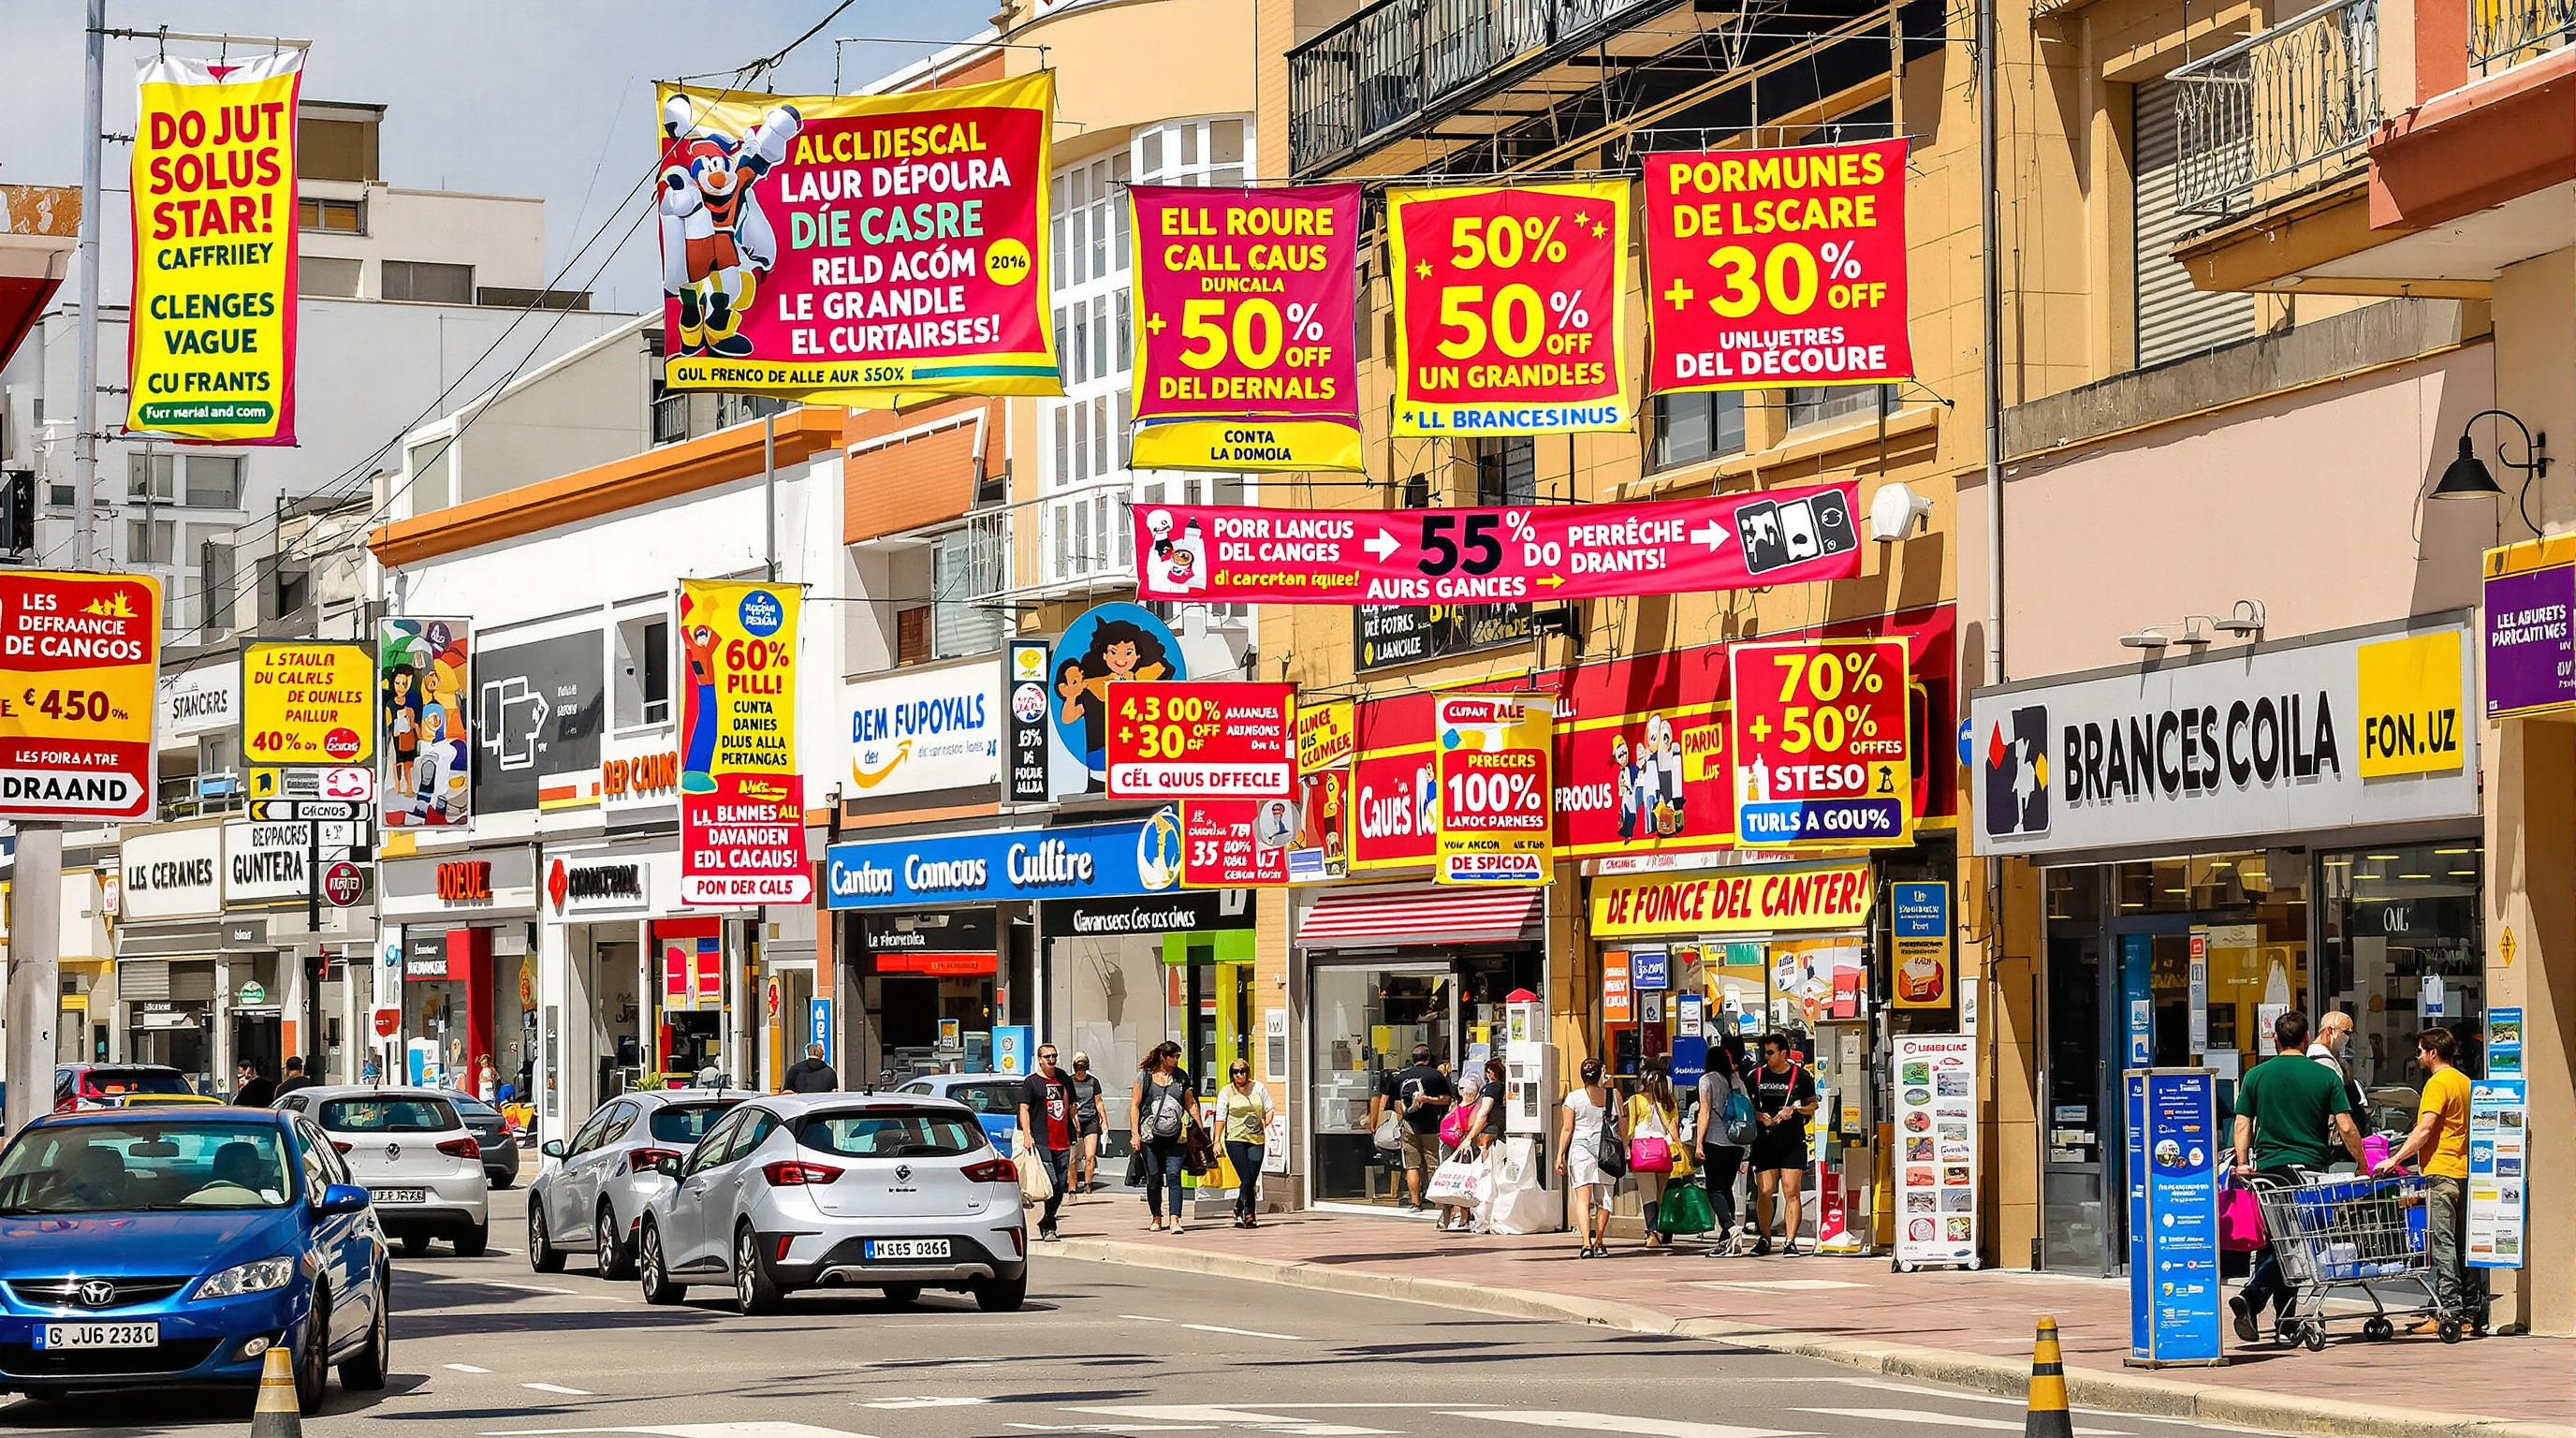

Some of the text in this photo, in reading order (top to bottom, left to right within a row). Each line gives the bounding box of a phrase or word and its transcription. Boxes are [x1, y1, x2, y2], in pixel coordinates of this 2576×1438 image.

[151, 101, 284, 150] DO JUT
[150, 146, 281, 195] SOLUS
[1669, 152, 1885, 196] PORMUNES
[781, 169, 863, 203] LAUR
[153, 193, 272, 241] STAR!
[790, 199, 984, 250] DÍE CASRE
[1161, 206, 1335, 236] ELL ROURE
[1673, 195, 1877, 238] DE LSCARE
[1450, 214, 1568, 270] 50%
[812, 243, 976, 286] RELD ACÓM
[1164, 243, 1328, 271] CALL CAUS
[1201, 276, 1285, 293] DUNCALA
[1827, 282, 1888, 310] OFF
[150, 291, 275, 320] CLENGES
[779, 285, 966, 321] LE GRANDLE
[164, 328, 257, 355] VAGUE
[791, 314, 1001, 355] EL CURTAIRSES!
[1545, 332, 1594, 356] OFF
[1285, 346, 1333, 369] OFF
[1676, 352, 1733, 378] DEL
[148, 371, 271, 394] CU FRANTS
[678, 367, 707, 382] GUL
[710, 368, 764, 382] PRENCO
[768, 370, 786, 383] DE
[789, 370, 825, 384] ALLE
[1160, 376, 1337, 401] DEL DERNALS
[1418, 362, 1606, 390] UN GRANDLES
[1454, 406, 1619, 429] BRANCESINUS
[1224, 430, 1276, 445] CONTA
[1210, 447, 1230, 462] LA
[1214, 518, 1354, 539] PORR LANCUS
[1219, 543, 1340, 562] DEL CANGES
[1523, 542, 1561, 567] DO
[1571, 548, 1667, 574] DRANTS!
[1366, 578, 1430, 600] AURS
[22, 594, 57, 611] LES
[19, 614, 126, 636] DEFRAANCIE
[6, 635, 142, 661] DE CANGOS
[726, 638, 789, 671] 60%
[255, 671, 273, 684] DU
[1773, 652, 1883, 703] 70%
[287, 690, 305, 703] DE
[734, 701, 773, 714] CUNTA
[895, 693, 985, 738] FUPOYALS
[253, 731, 301, 751] 40%
[756, 736, 786, 750] ALLA
[1137, 724, 1185, 759] 30
[16, 750, 38, 764] LES
[1159, 771, 1205, 788] QUUS
[1775, 763, 1866, 792] STESO
[1447, 772, 1542, 813] 100%
[1747, 808, 1891, 832] TURLS A GOU%
[694, 848, 798, 869] EDL CACAUS!
[1191, 841, 1220, 867] 35
[1452, 857, 1472, 871] DE
[233, 850, 304, 886] GUNTERA
[697, 880, 726, 895] PON
[731, 880, 756, 895] DER
[1606, 888, 1632, 925] DE
[1712, 878, 1752, 919] DEL
[1762, 869, 1869, 917] CANTER!
